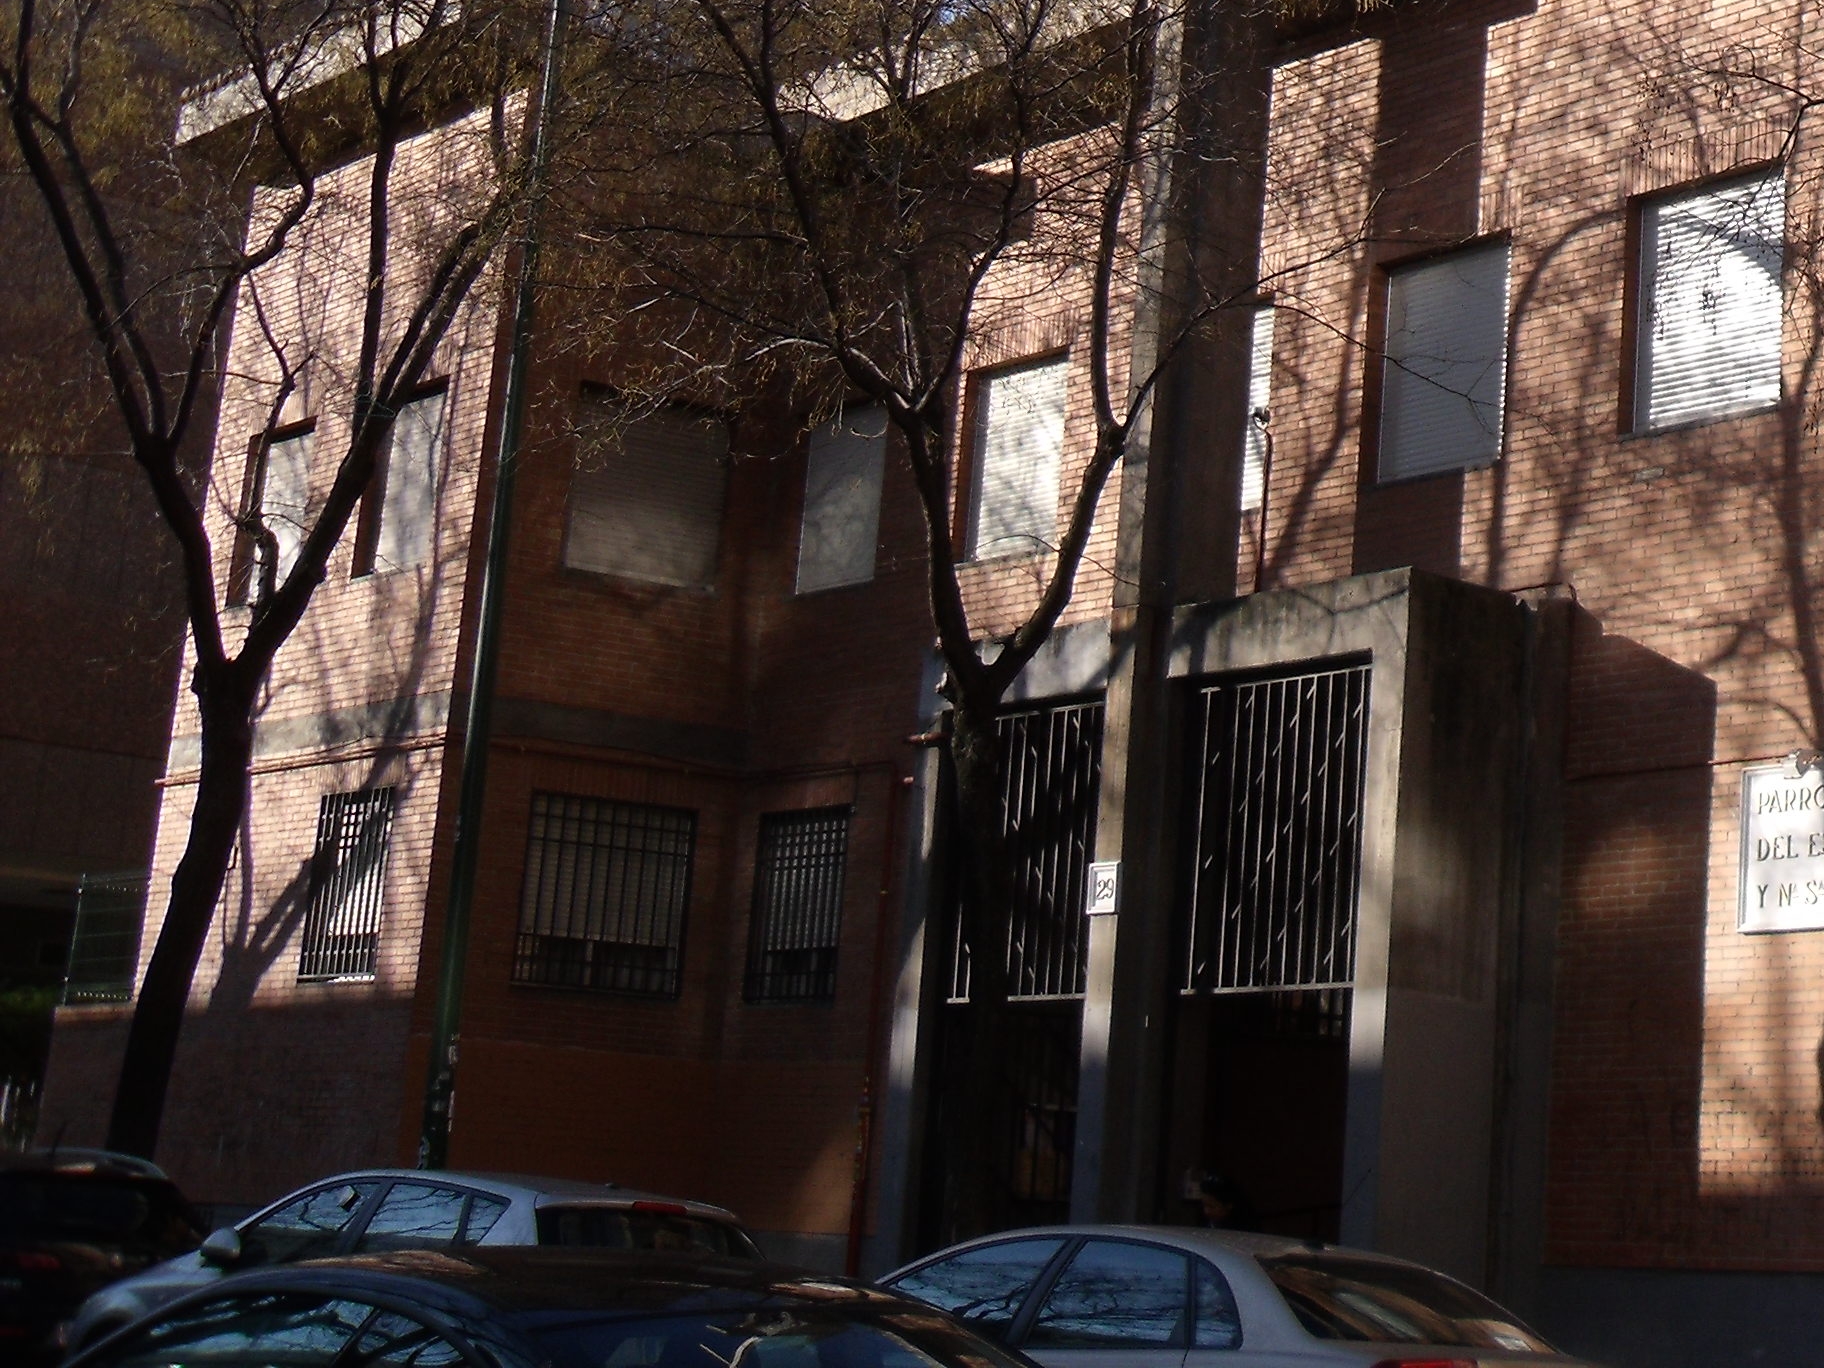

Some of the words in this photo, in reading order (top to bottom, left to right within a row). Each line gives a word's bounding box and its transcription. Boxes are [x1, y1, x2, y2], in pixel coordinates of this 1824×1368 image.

[1757, 833, 1799, 862] DEL
[1096, 878, 1115, 900] 29
[1757, 883, 1769, 909] Y
